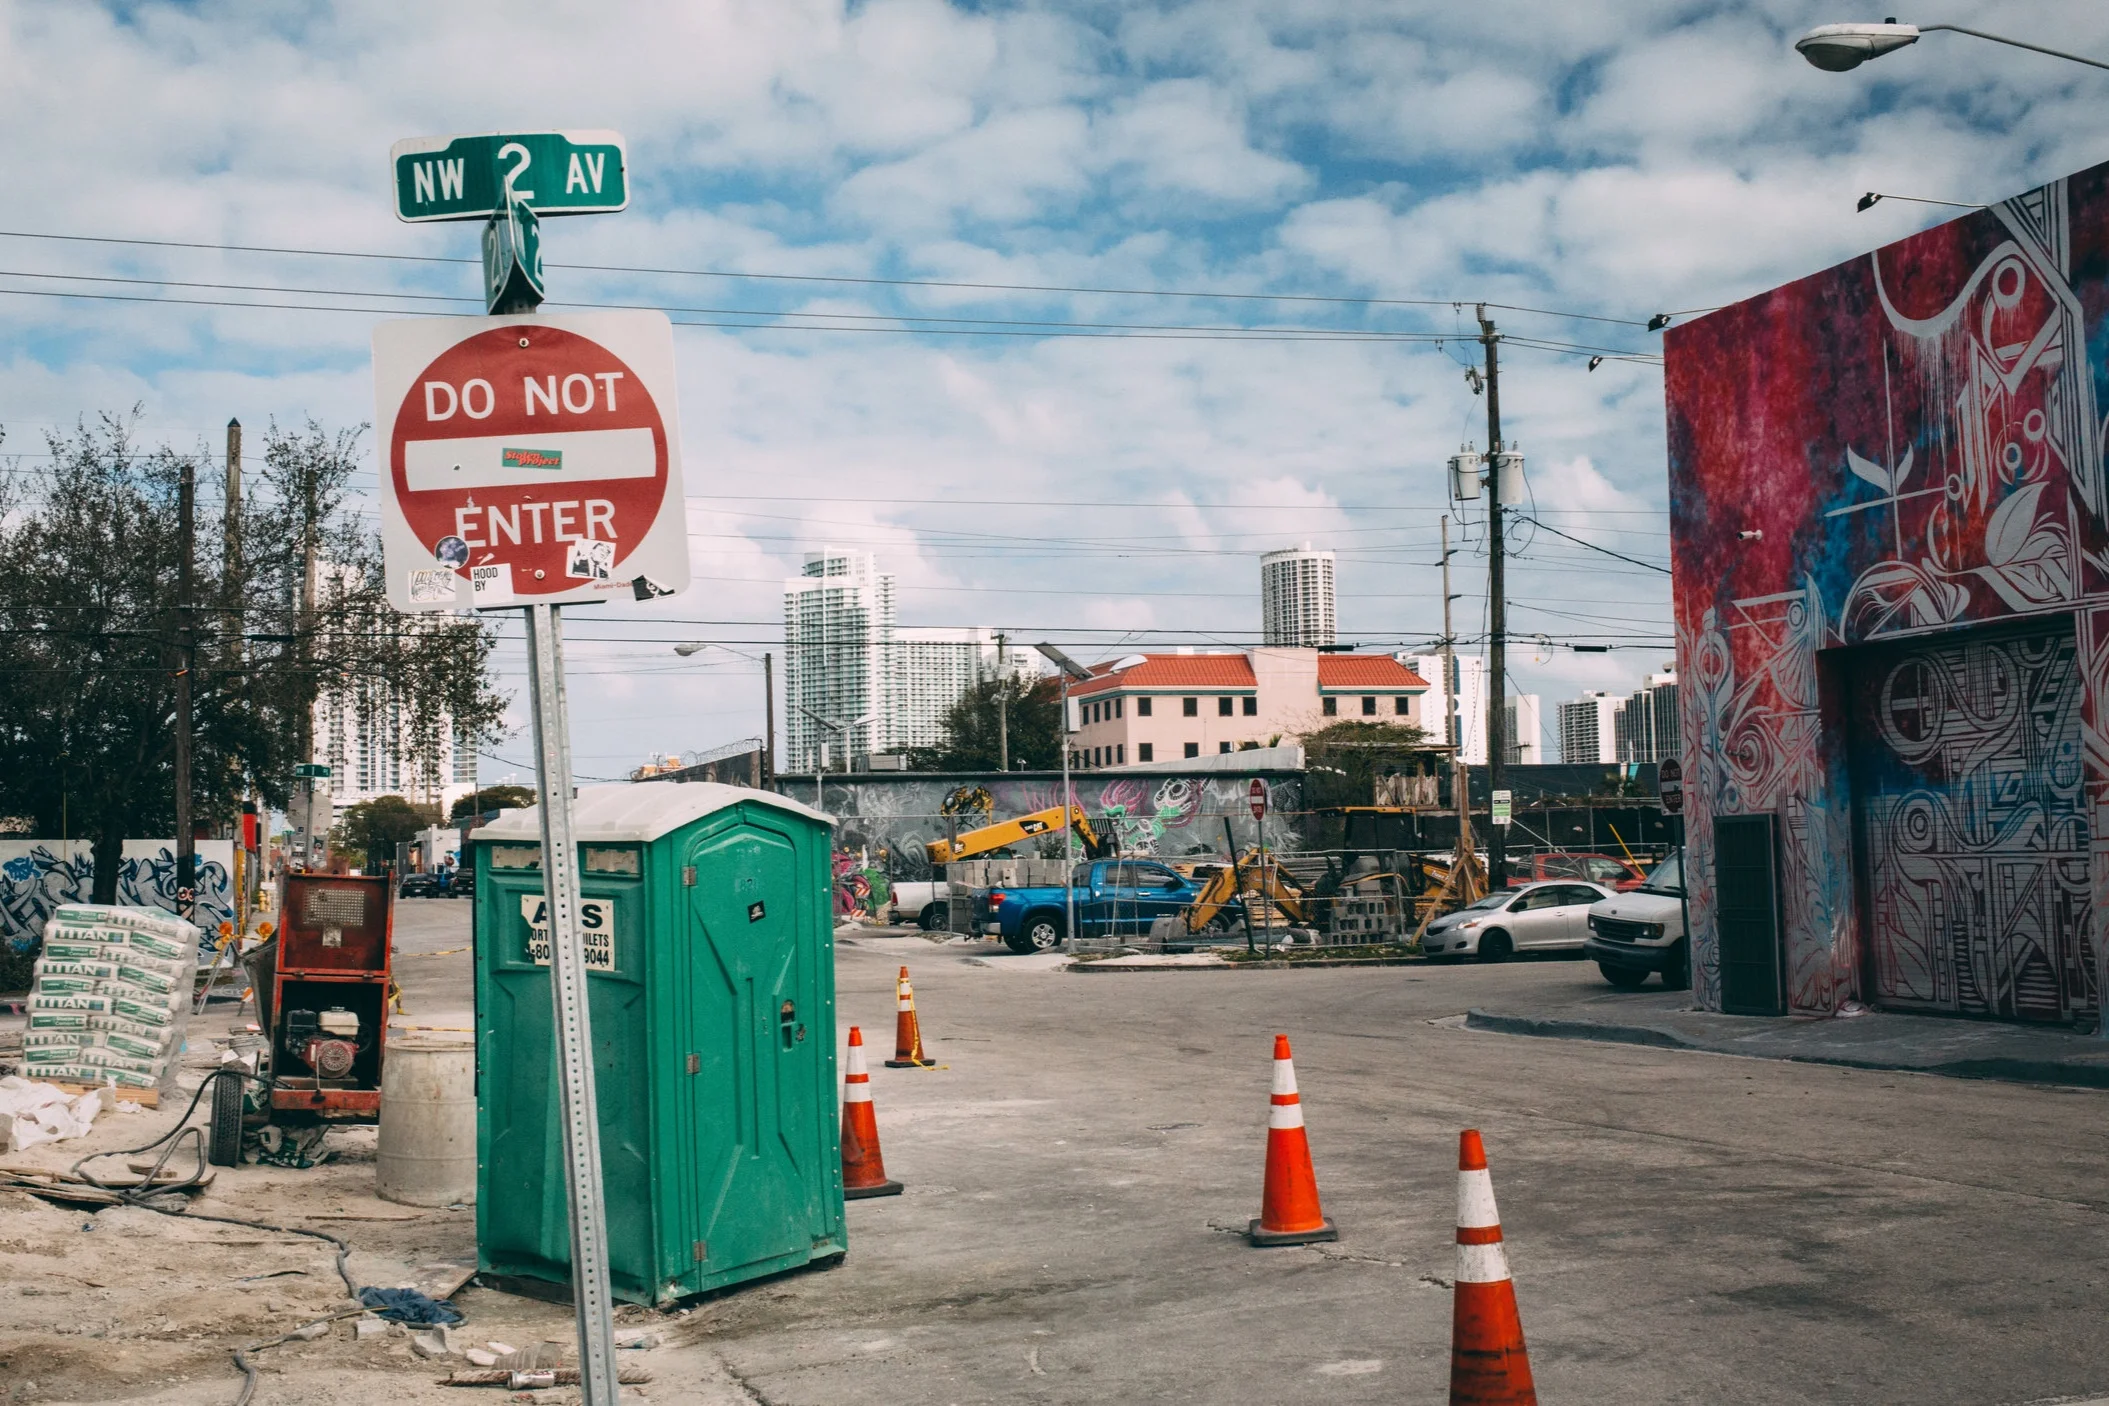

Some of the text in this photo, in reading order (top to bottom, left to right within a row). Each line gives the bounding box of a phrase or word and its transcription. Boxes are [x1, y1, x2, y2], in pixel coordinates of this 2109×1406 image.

[413, 143, 605, 203] NW 2 AV
[424, 371, 624, 421] DO NOT
[454, 499, 618, 548] ENTER
[473, 567, 498, 579] HOOD
[475, 580, 486, 591] BY
[58, 928, 110, 942] TITAN
[44, 963, 97, 976] TITAN
[37, 999, 90, 1009] TITAN
[28, 1034, 80, 1046] TITAN
[30, 1067, 81, 1077] TITAN
